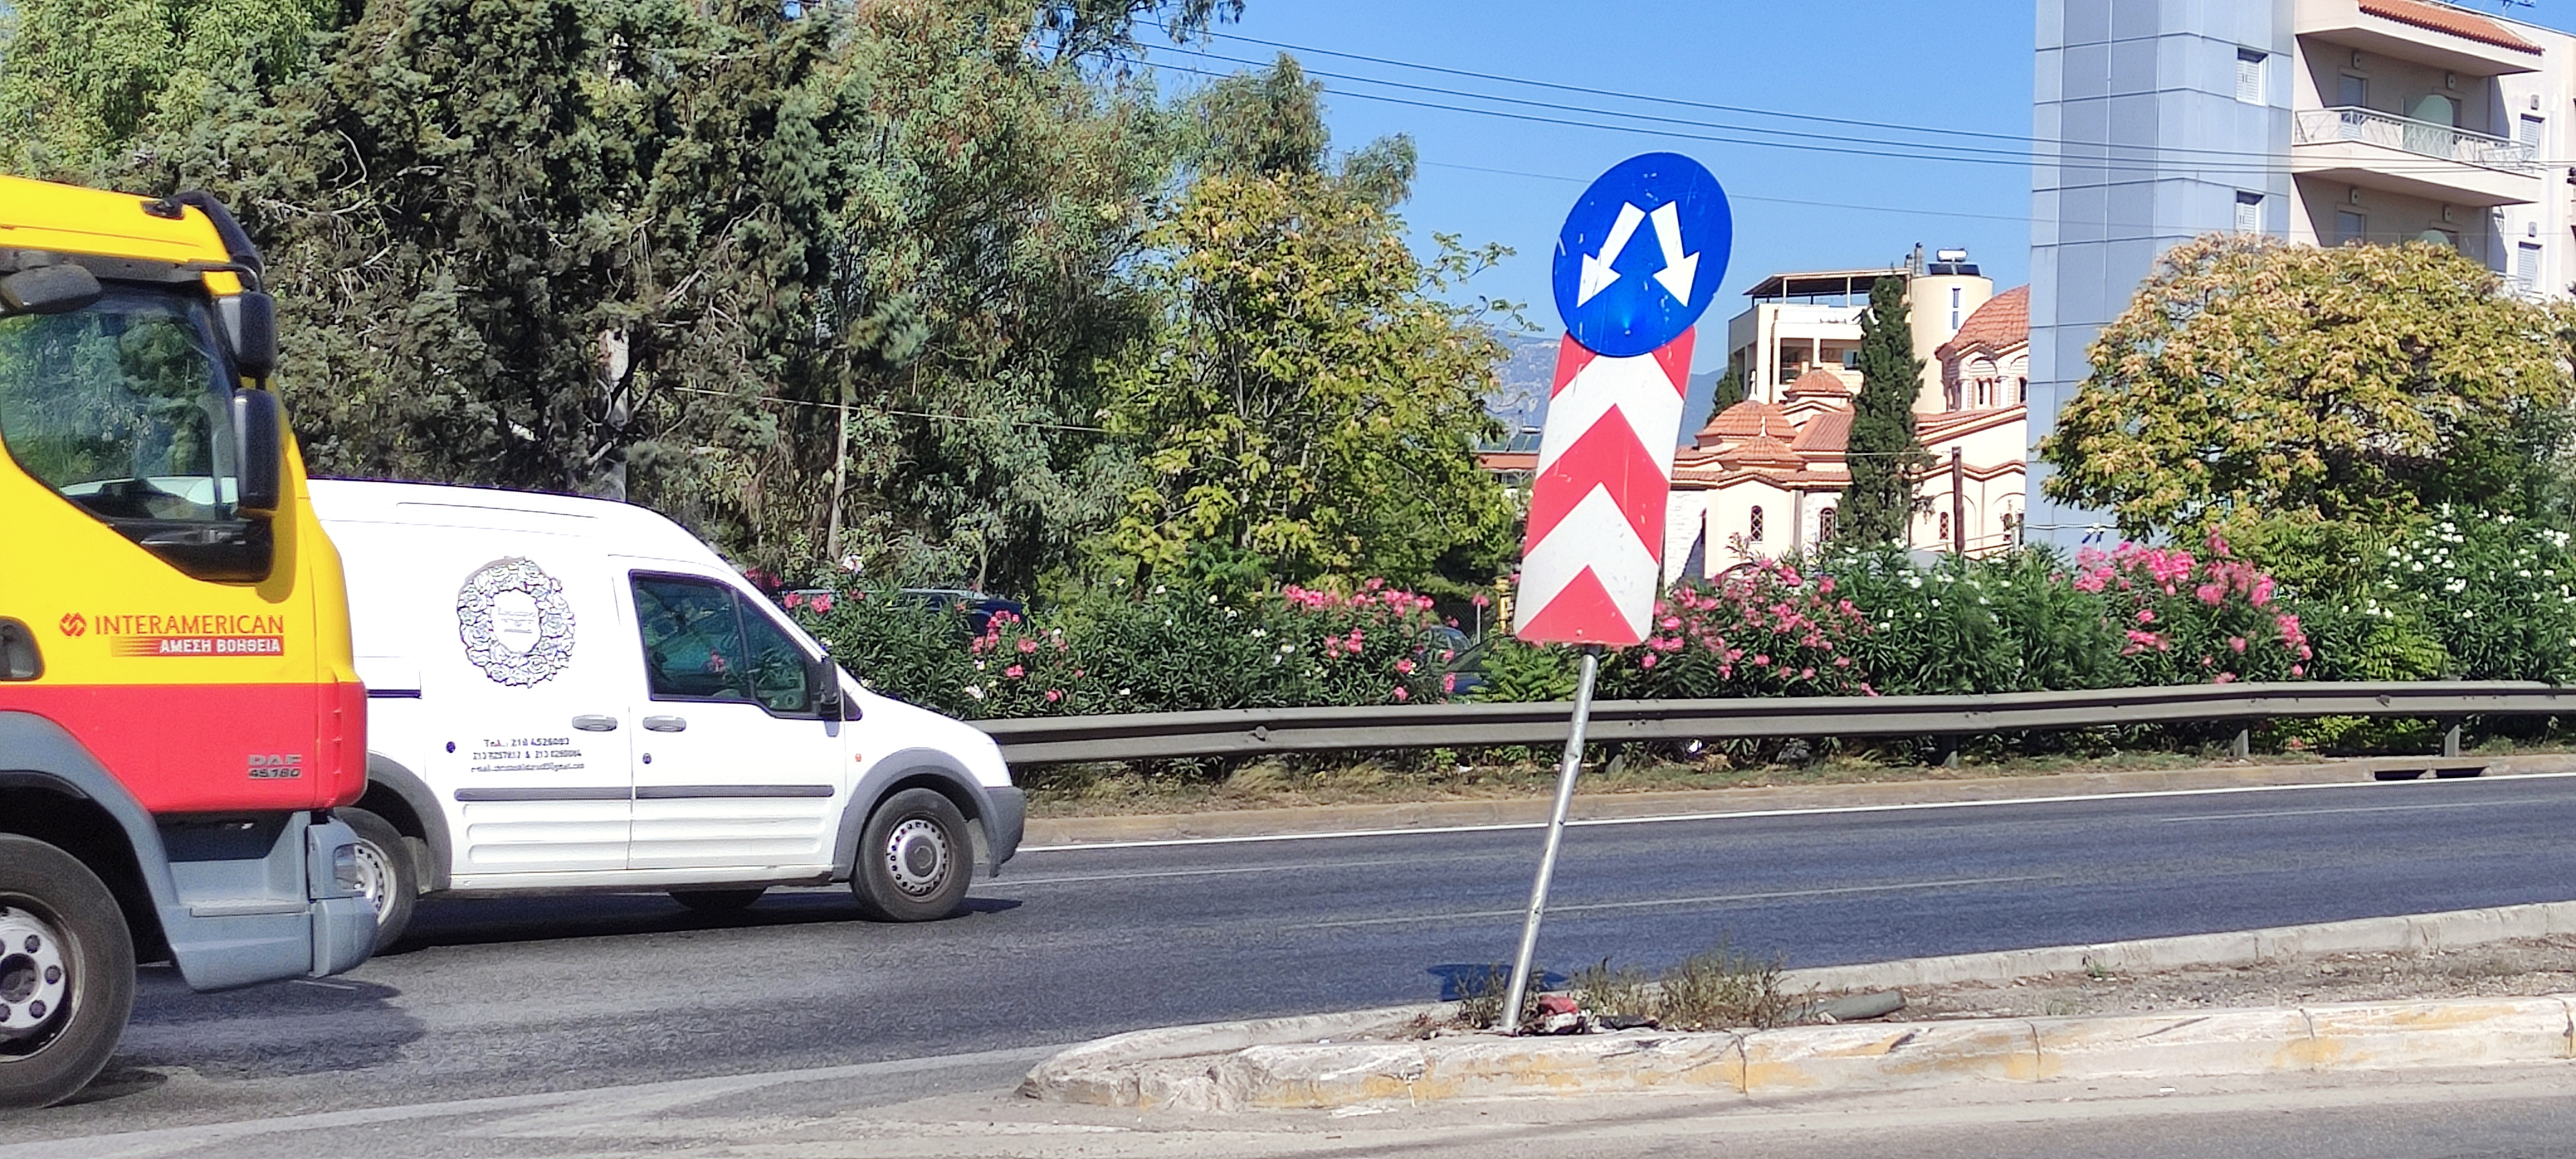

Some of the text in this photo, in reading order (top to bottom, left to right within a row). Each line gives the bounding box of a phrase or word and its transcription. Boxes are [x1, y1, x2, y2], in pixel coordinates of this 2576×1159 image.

[95, 615, 284, 635] INTERAMERICAN
[159, 638, 281, 654] ΑΜΕΣΗ ΒΟΗΘΕΙΑ
[248, 754, 302, 766] DAF
